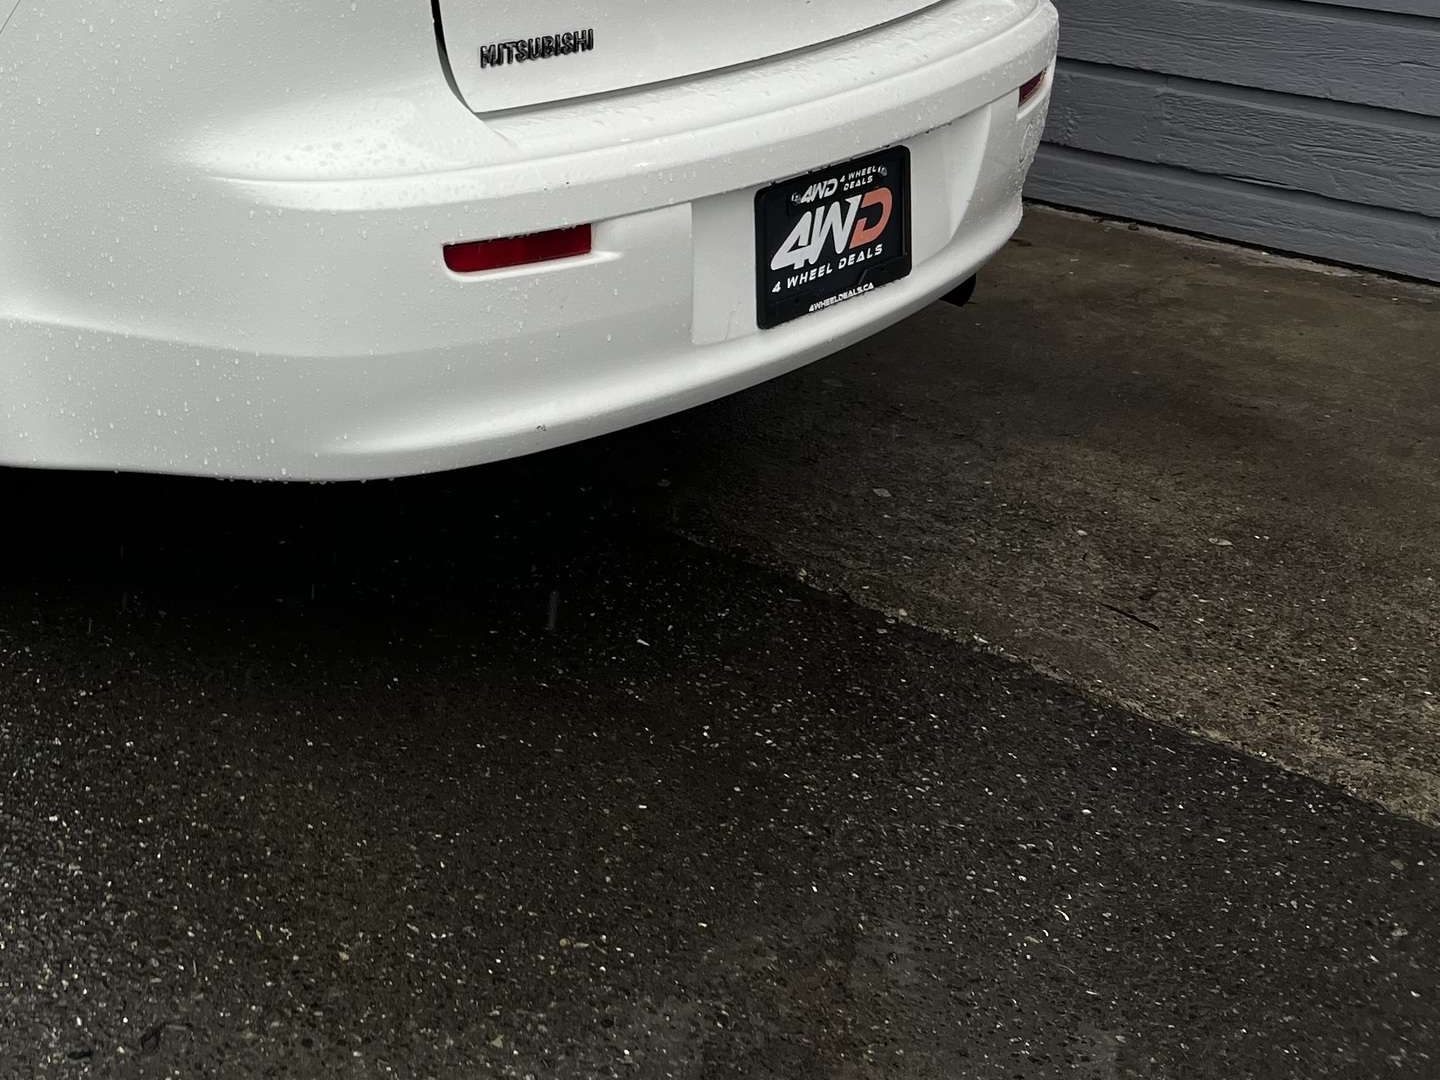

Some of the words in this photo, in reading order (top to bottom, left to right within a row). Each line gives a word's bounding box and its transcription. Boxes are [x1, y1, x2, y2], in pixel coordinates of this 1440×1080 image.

[480, 28, 594, 69] MITSUBISHI
[843, 175, 873, 191] DEALS
[848, 165, 877, 181] WHEEL
[771, 187, 893, 270] 4WD
[772, 281, 782, 293] 4
[787, 263, 833, 289] WHEEL
[838, 244, 883, 270] DEALS
